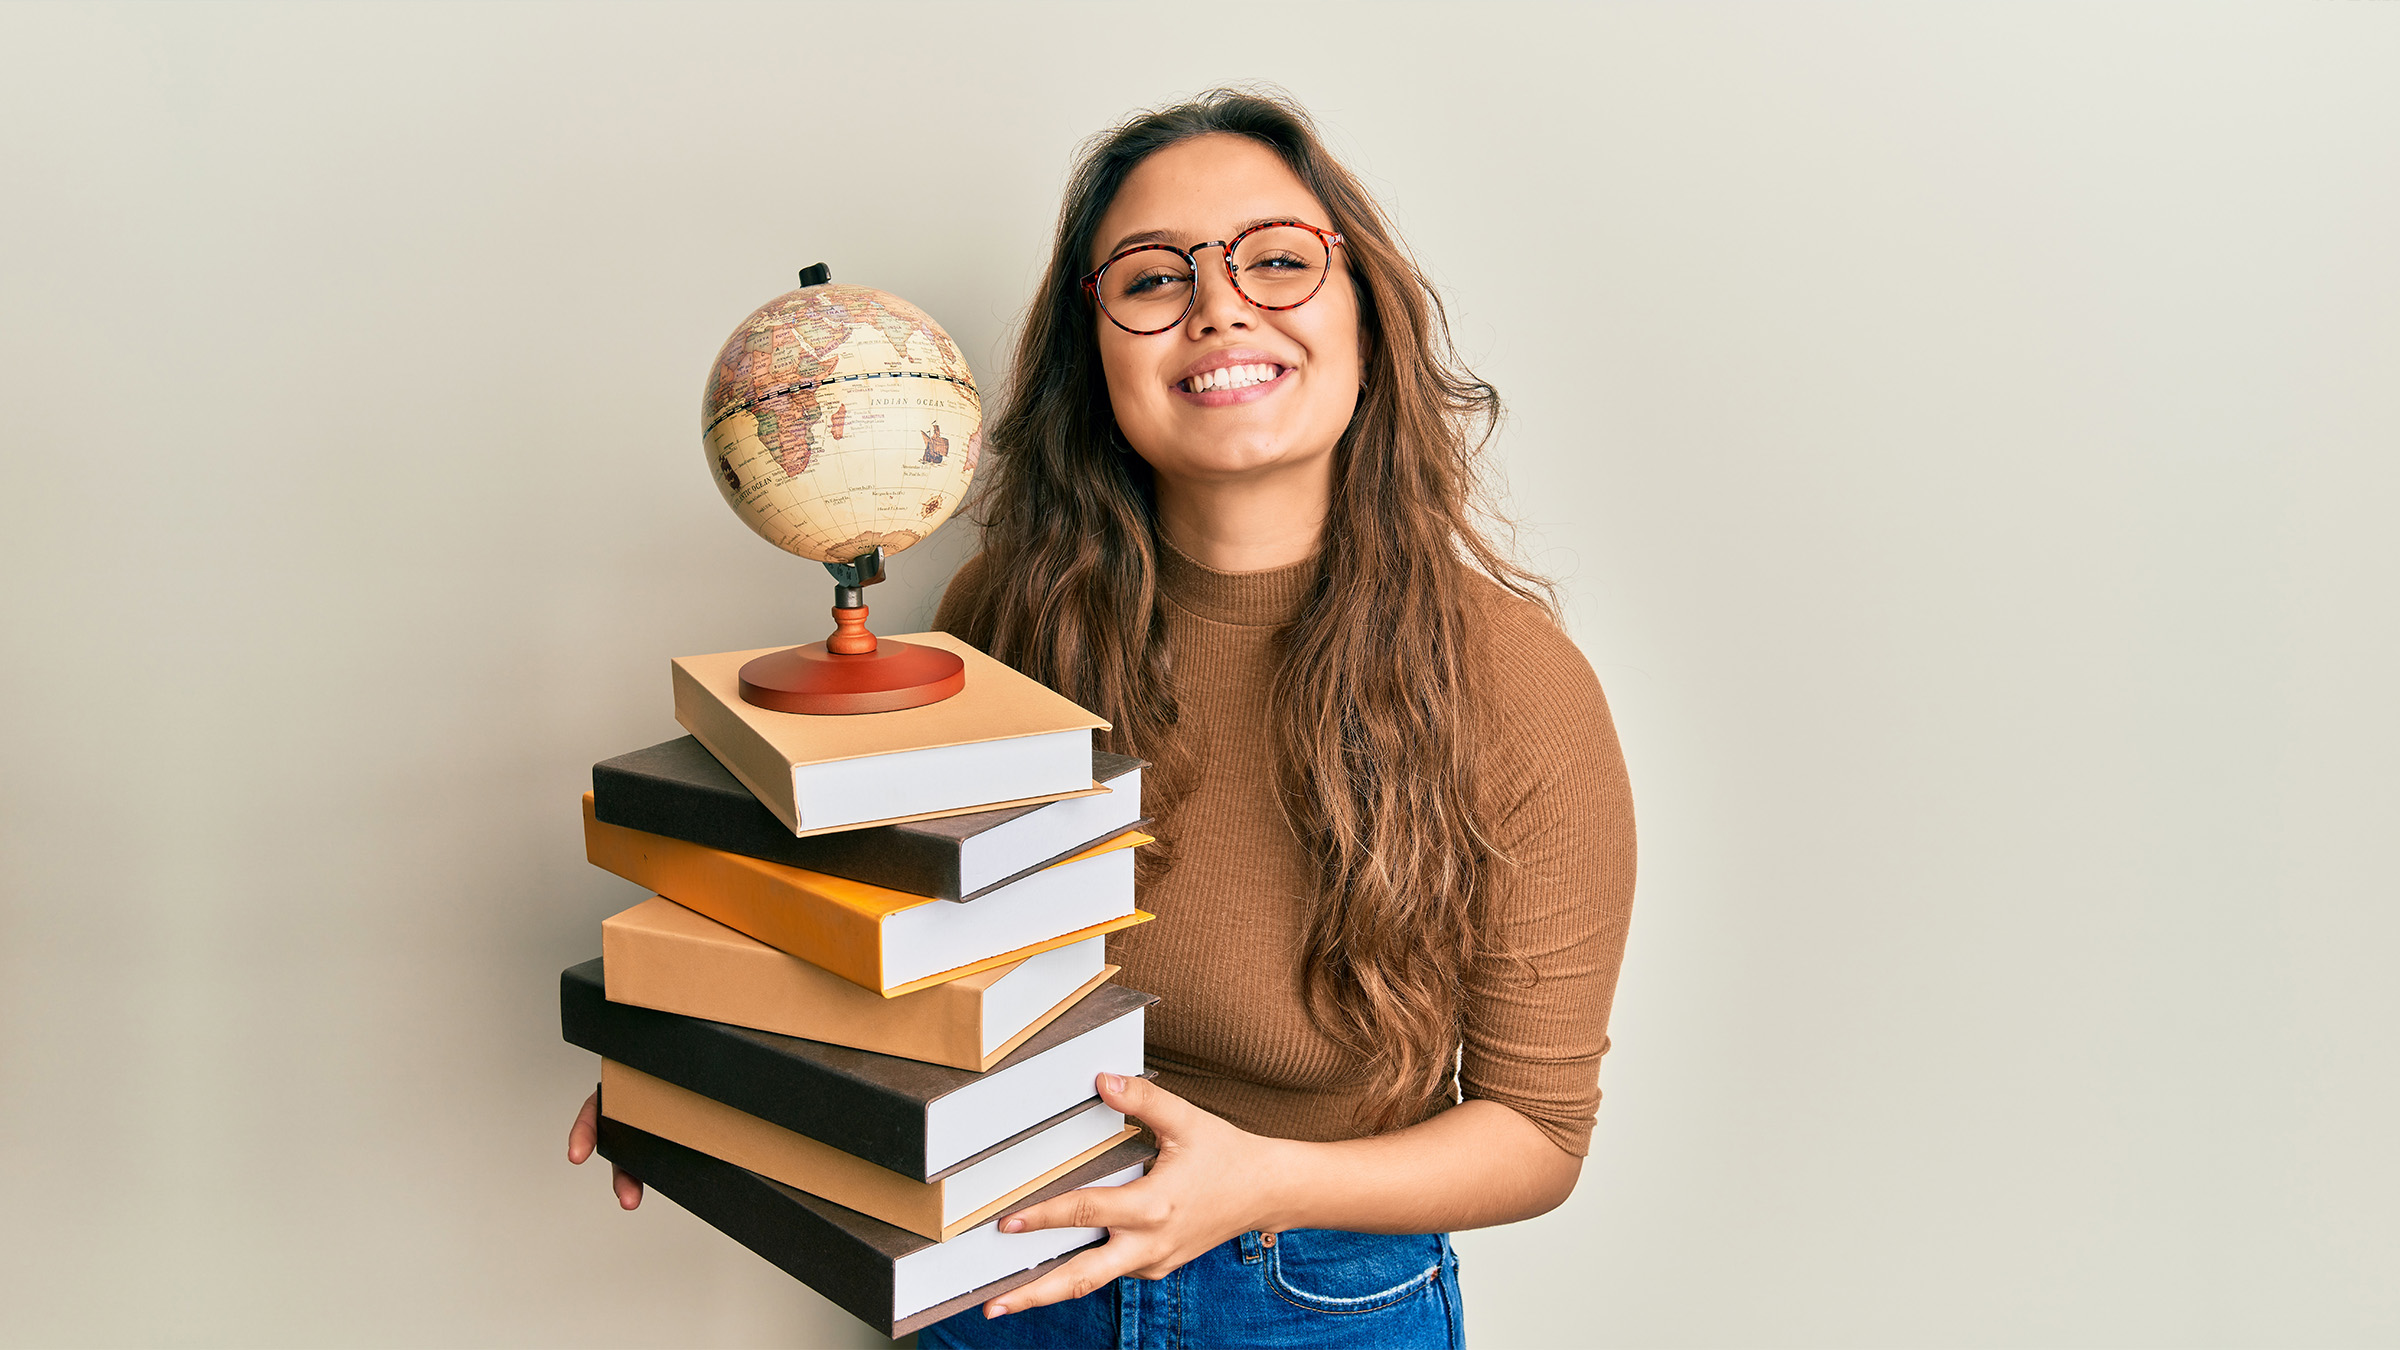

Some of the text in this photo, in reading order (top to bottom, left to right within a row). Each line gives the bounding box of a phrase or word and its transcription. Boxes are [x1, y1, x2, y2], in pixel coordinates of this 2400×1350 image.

[870, 398, 909, 406] INDIAN
[916, 398, 945, 407] OCEAN
[733, 487, 753, 509] ATLANTIC
[751, 475, 772, 492] OCEAN
